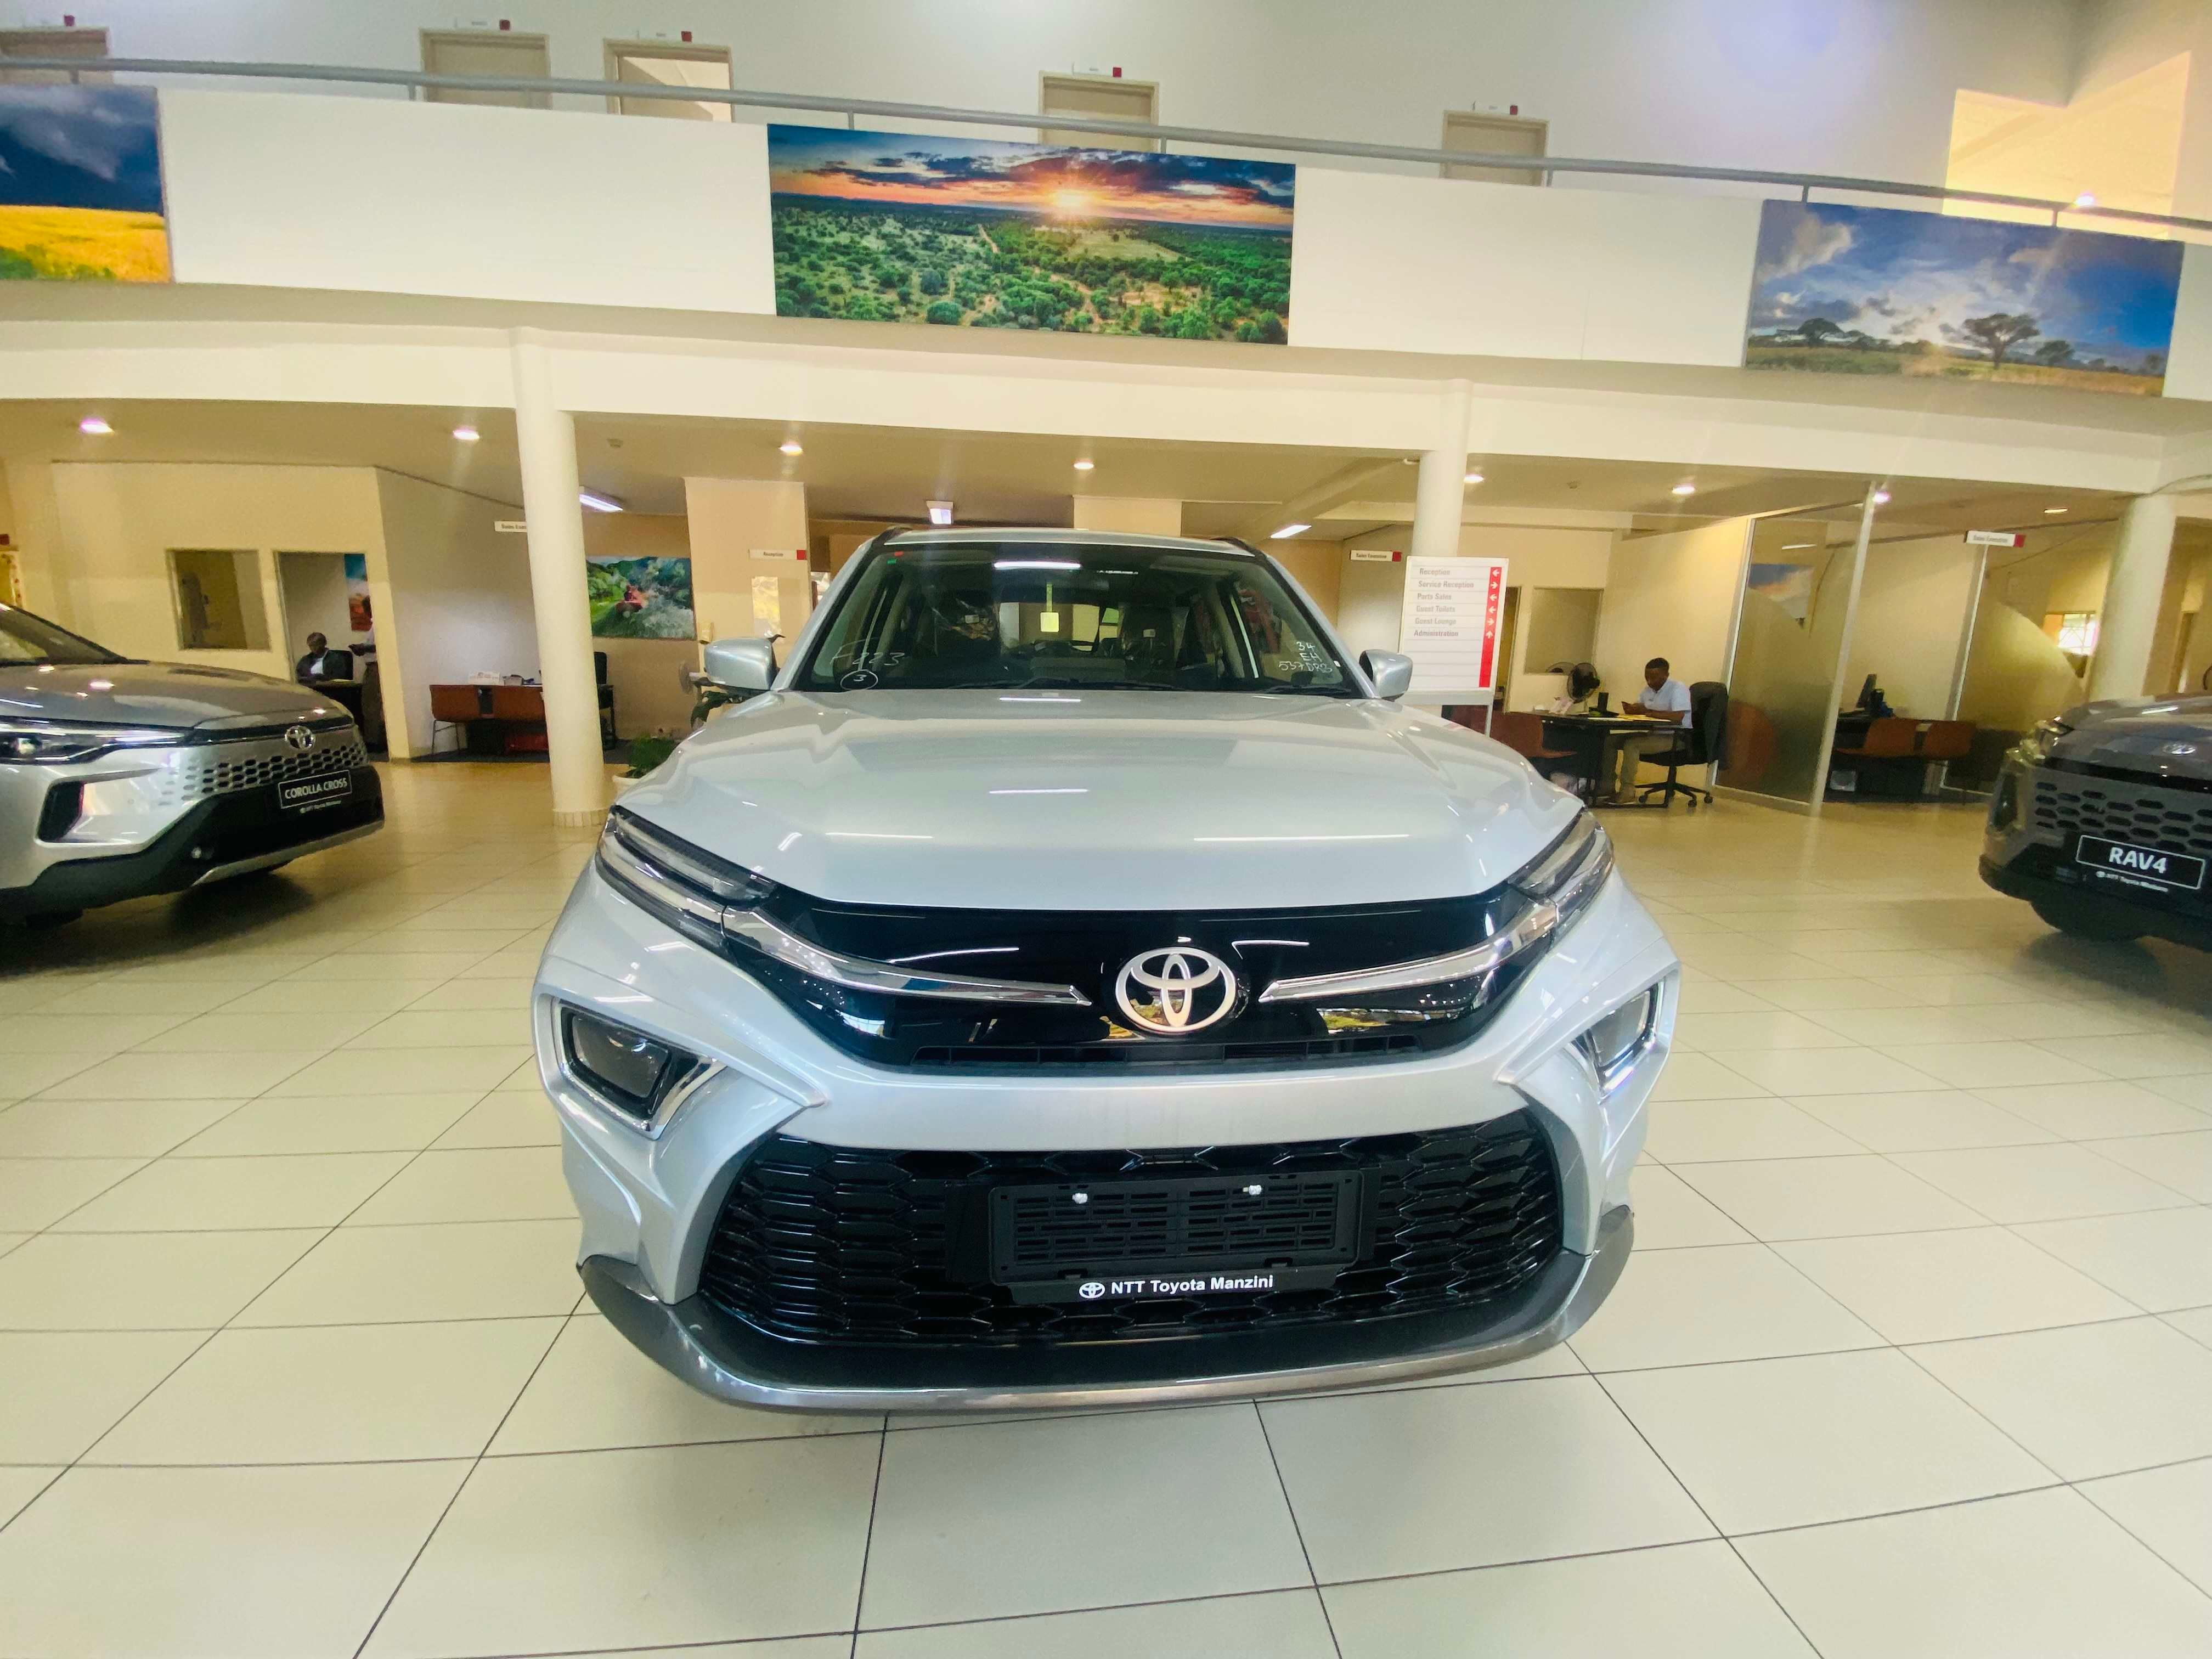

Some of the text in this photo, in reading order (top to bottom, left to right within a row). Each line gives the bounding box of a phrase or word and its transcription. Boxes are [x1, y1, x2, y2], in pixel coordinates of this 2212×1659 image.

[1443, 580, 1474, 589] Reception
[285, 777, 348, 799] COROLLA CROSS
[2108, 847, 2167, 874] RAV4
[1111, 1274, 1274, 1295] NTT Toyota Manzini
